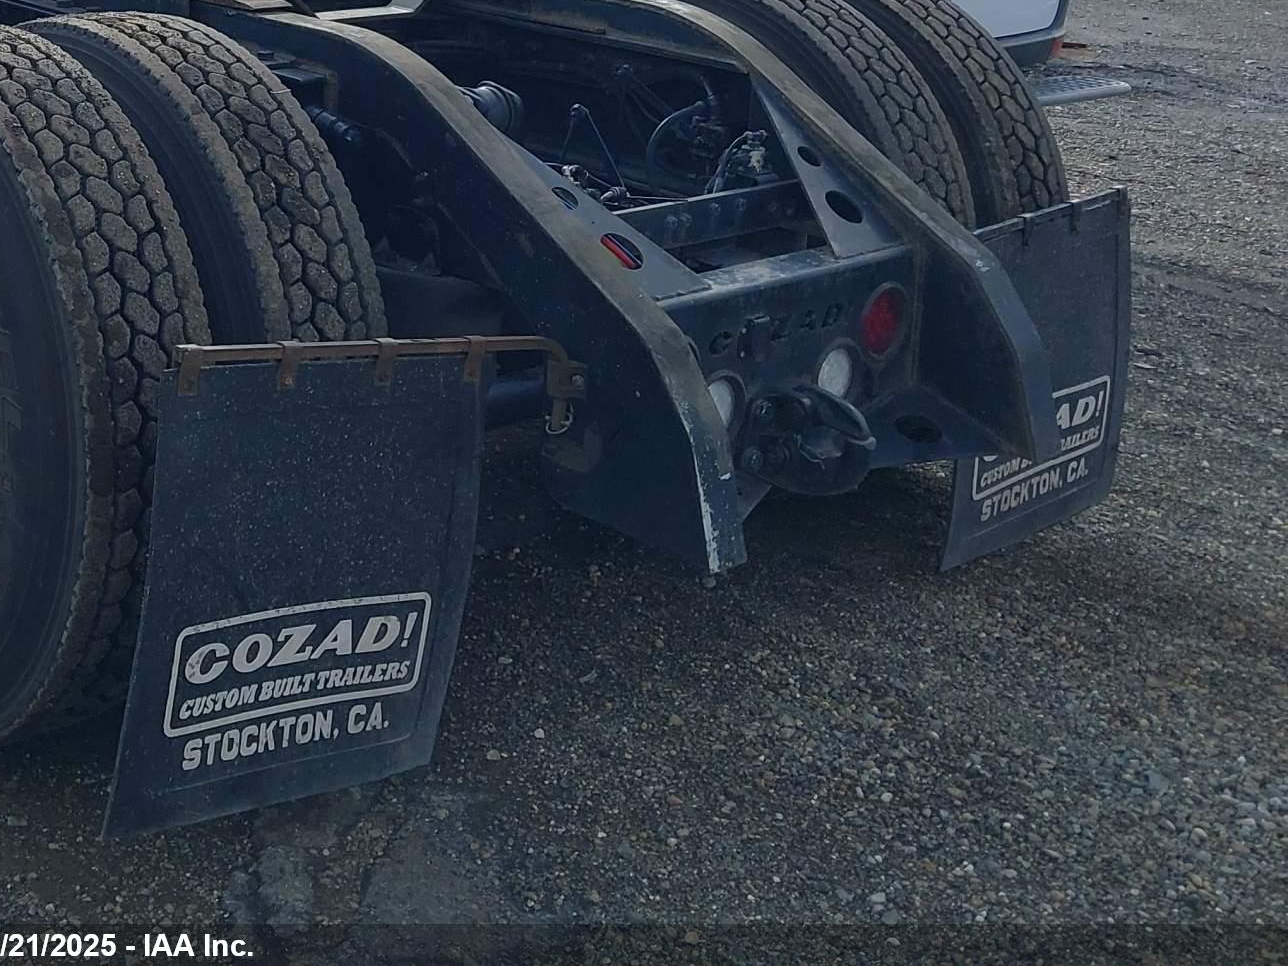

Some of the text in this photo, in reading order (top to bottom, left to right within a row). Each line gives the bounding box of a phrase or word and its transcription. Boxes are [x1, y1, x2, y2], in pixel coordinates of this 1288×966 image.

[1056, 390, 1104, 430] AD!
[1066, 457, 1089, 483] CA.
[184, 612, 418, 685] COZAD!
[179, 660, 411, 720] CUSTOM BUILT TRAILERS
[182, 701, 390, 771] STOCKTON, CA.
